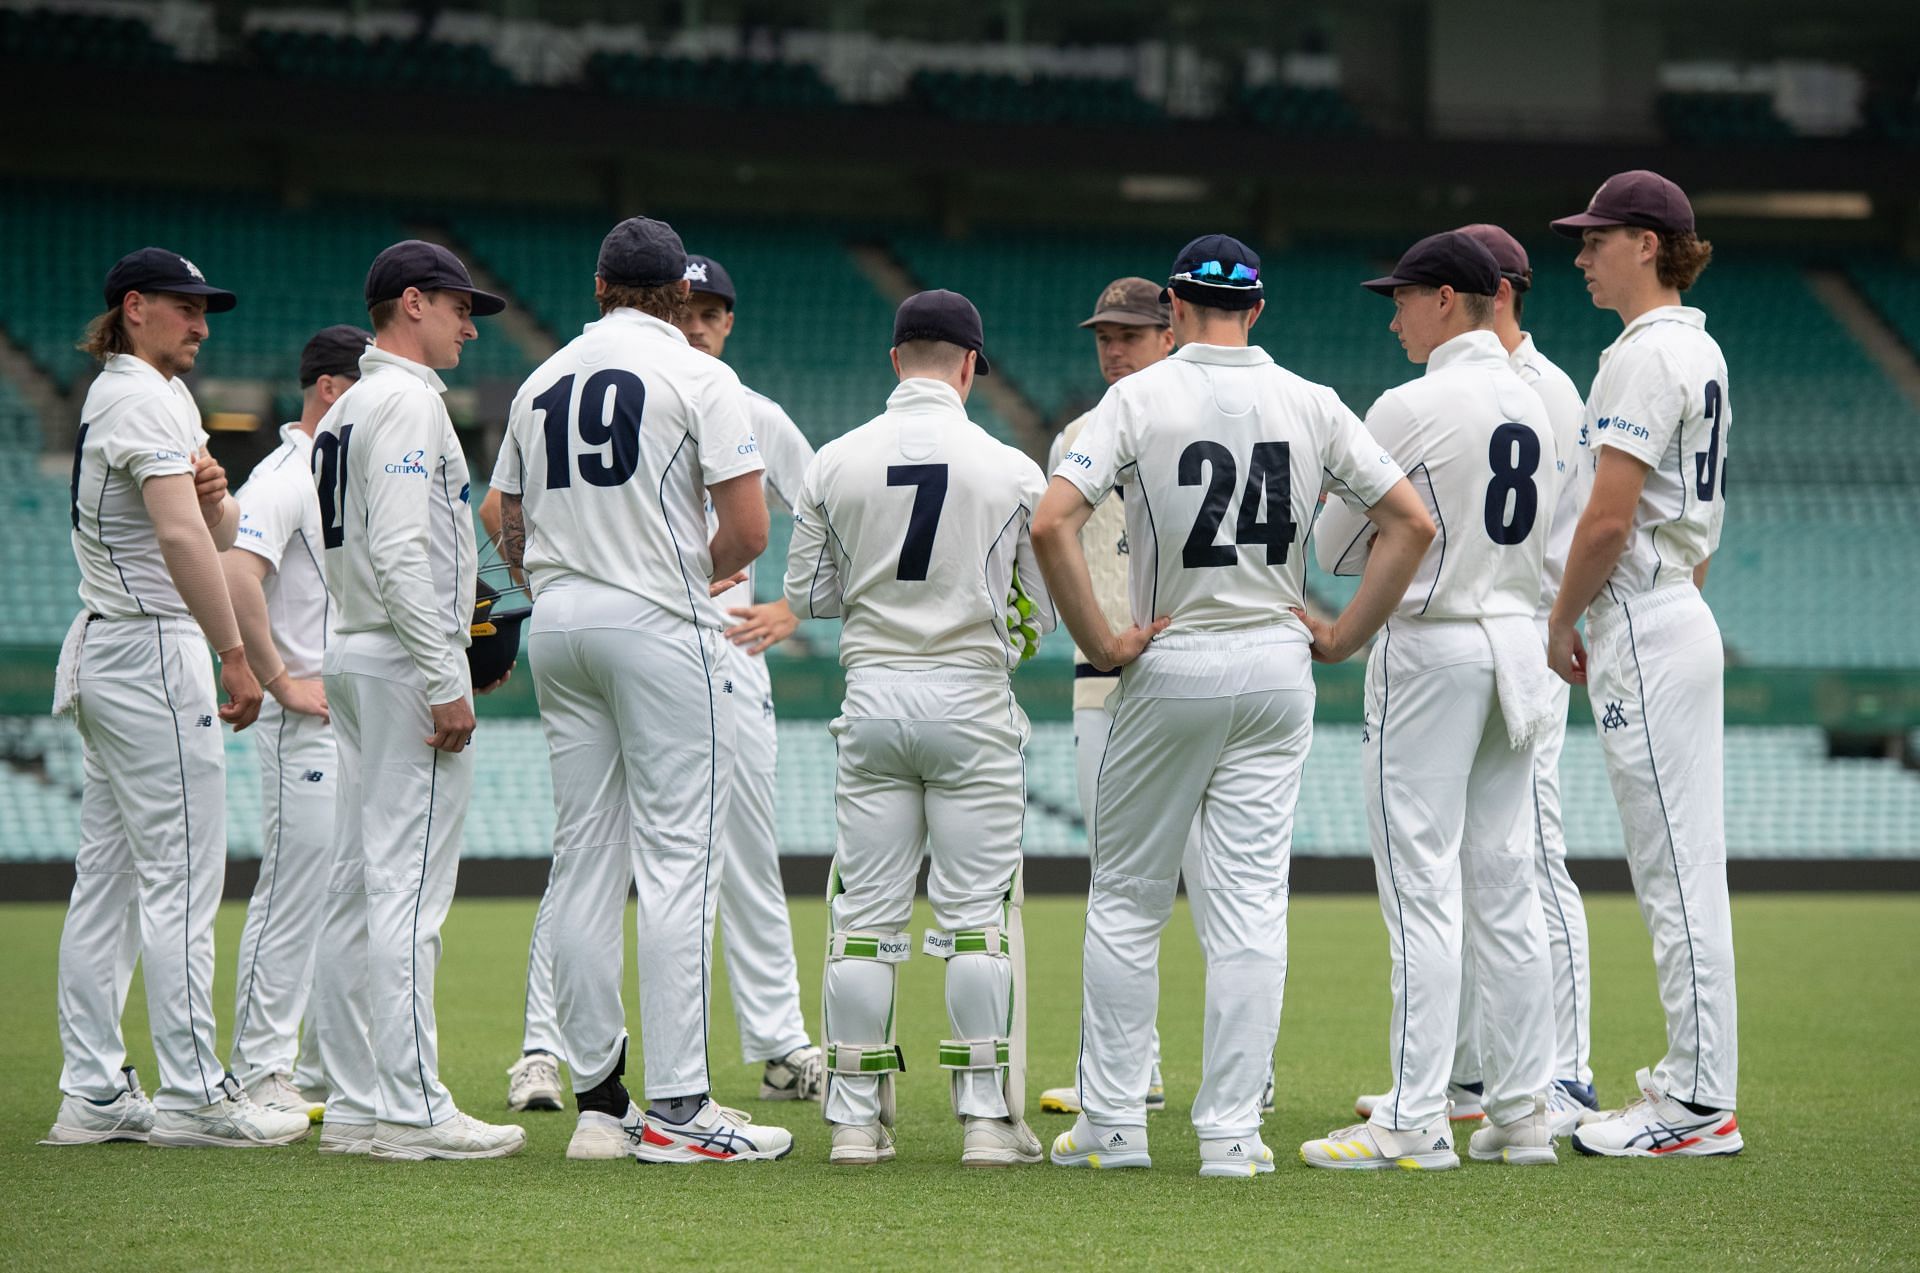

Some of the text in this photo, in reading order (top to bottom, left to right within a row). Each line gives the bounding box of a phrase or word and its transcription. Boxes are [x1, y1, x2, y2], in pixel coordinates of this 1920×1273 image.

[532, 369, 646, 490] 19
[1484, 422, 1541, 546] 8
[1695, 380, 1728, 502] 3
[886, 463, 948, 582] 7
[1178, 440, 1298, 569] 24
